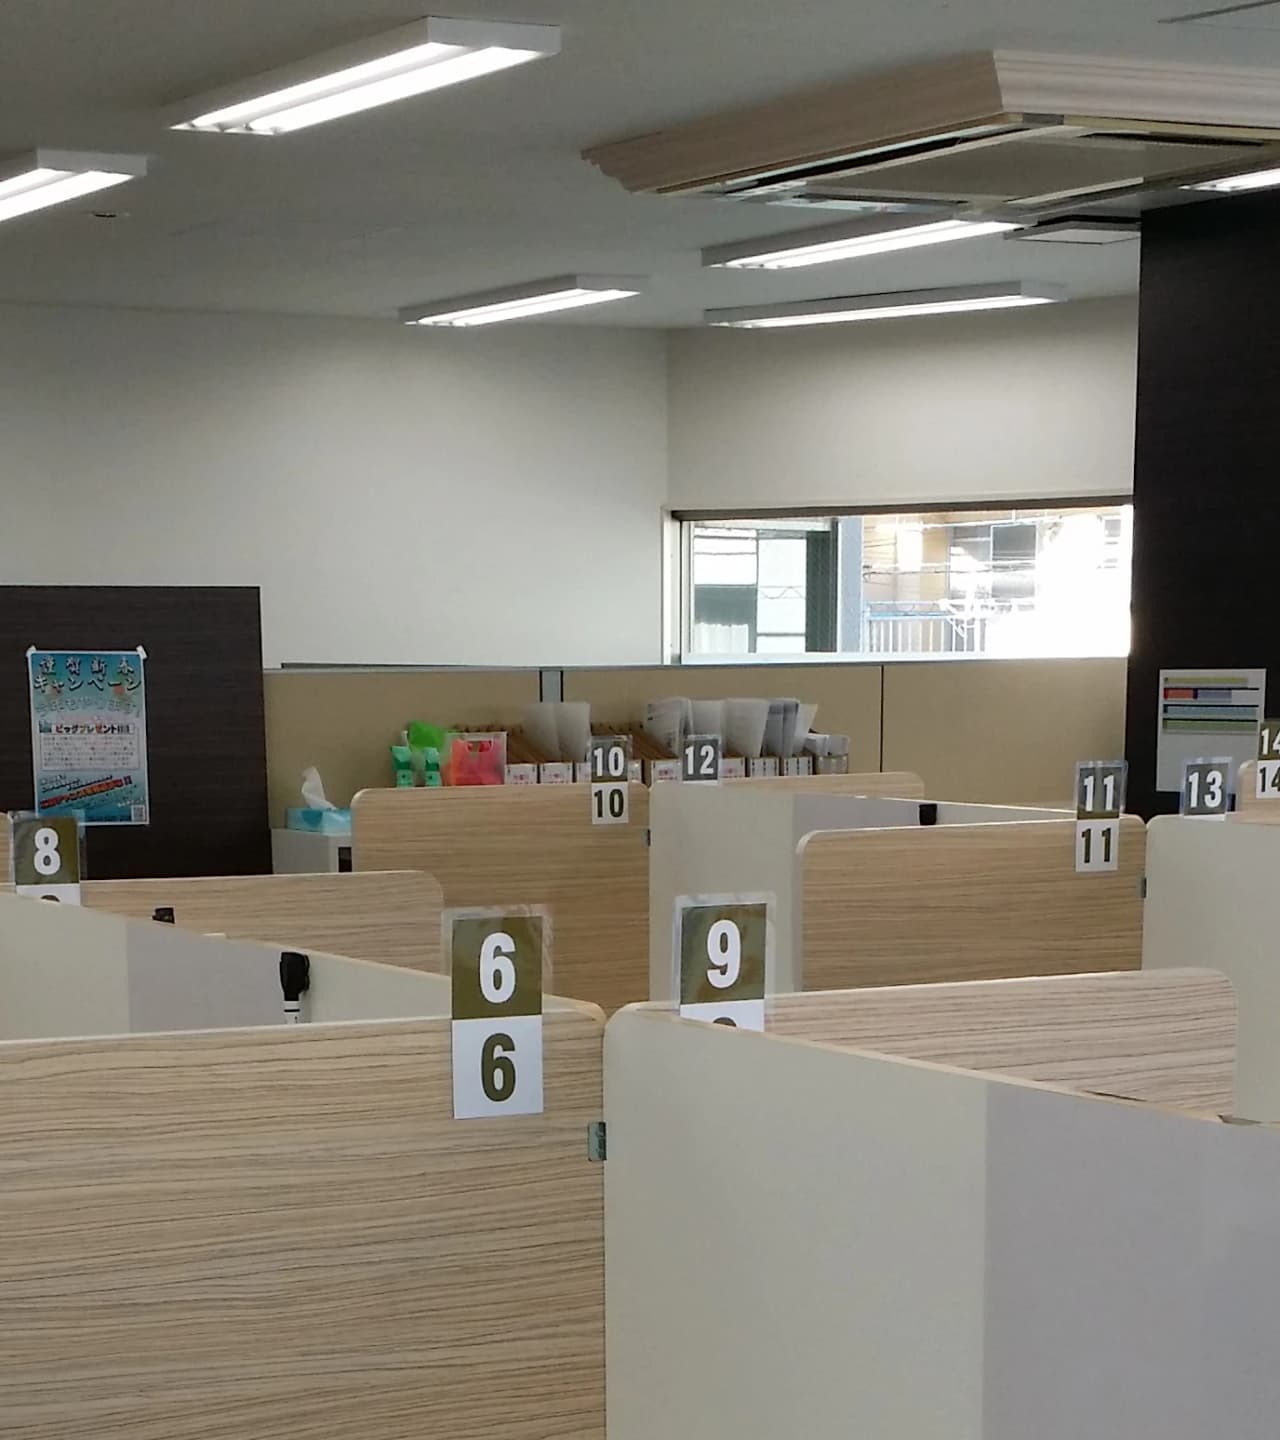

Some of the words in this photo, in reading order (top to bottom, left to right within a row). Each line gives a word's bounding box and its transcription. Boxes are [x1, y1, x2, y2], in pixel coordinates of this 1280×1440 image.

[33, 675, 141, 693] キャンペーン
[593, 746, 625, 777] 10
[685, 745, 714, 775] 12
[594, 789, 624, 818] 10
[1083, 775, 1114, 812] 11
[1188, 770, 1222, 808] 13
[34, 827, 61, 876] 8
[1081, 827, 1111, 863] 11
[479, 932, 516, 1004] 6
[706, 919, 741, 989] 9
[481, 1032, 516, 1102] 6
